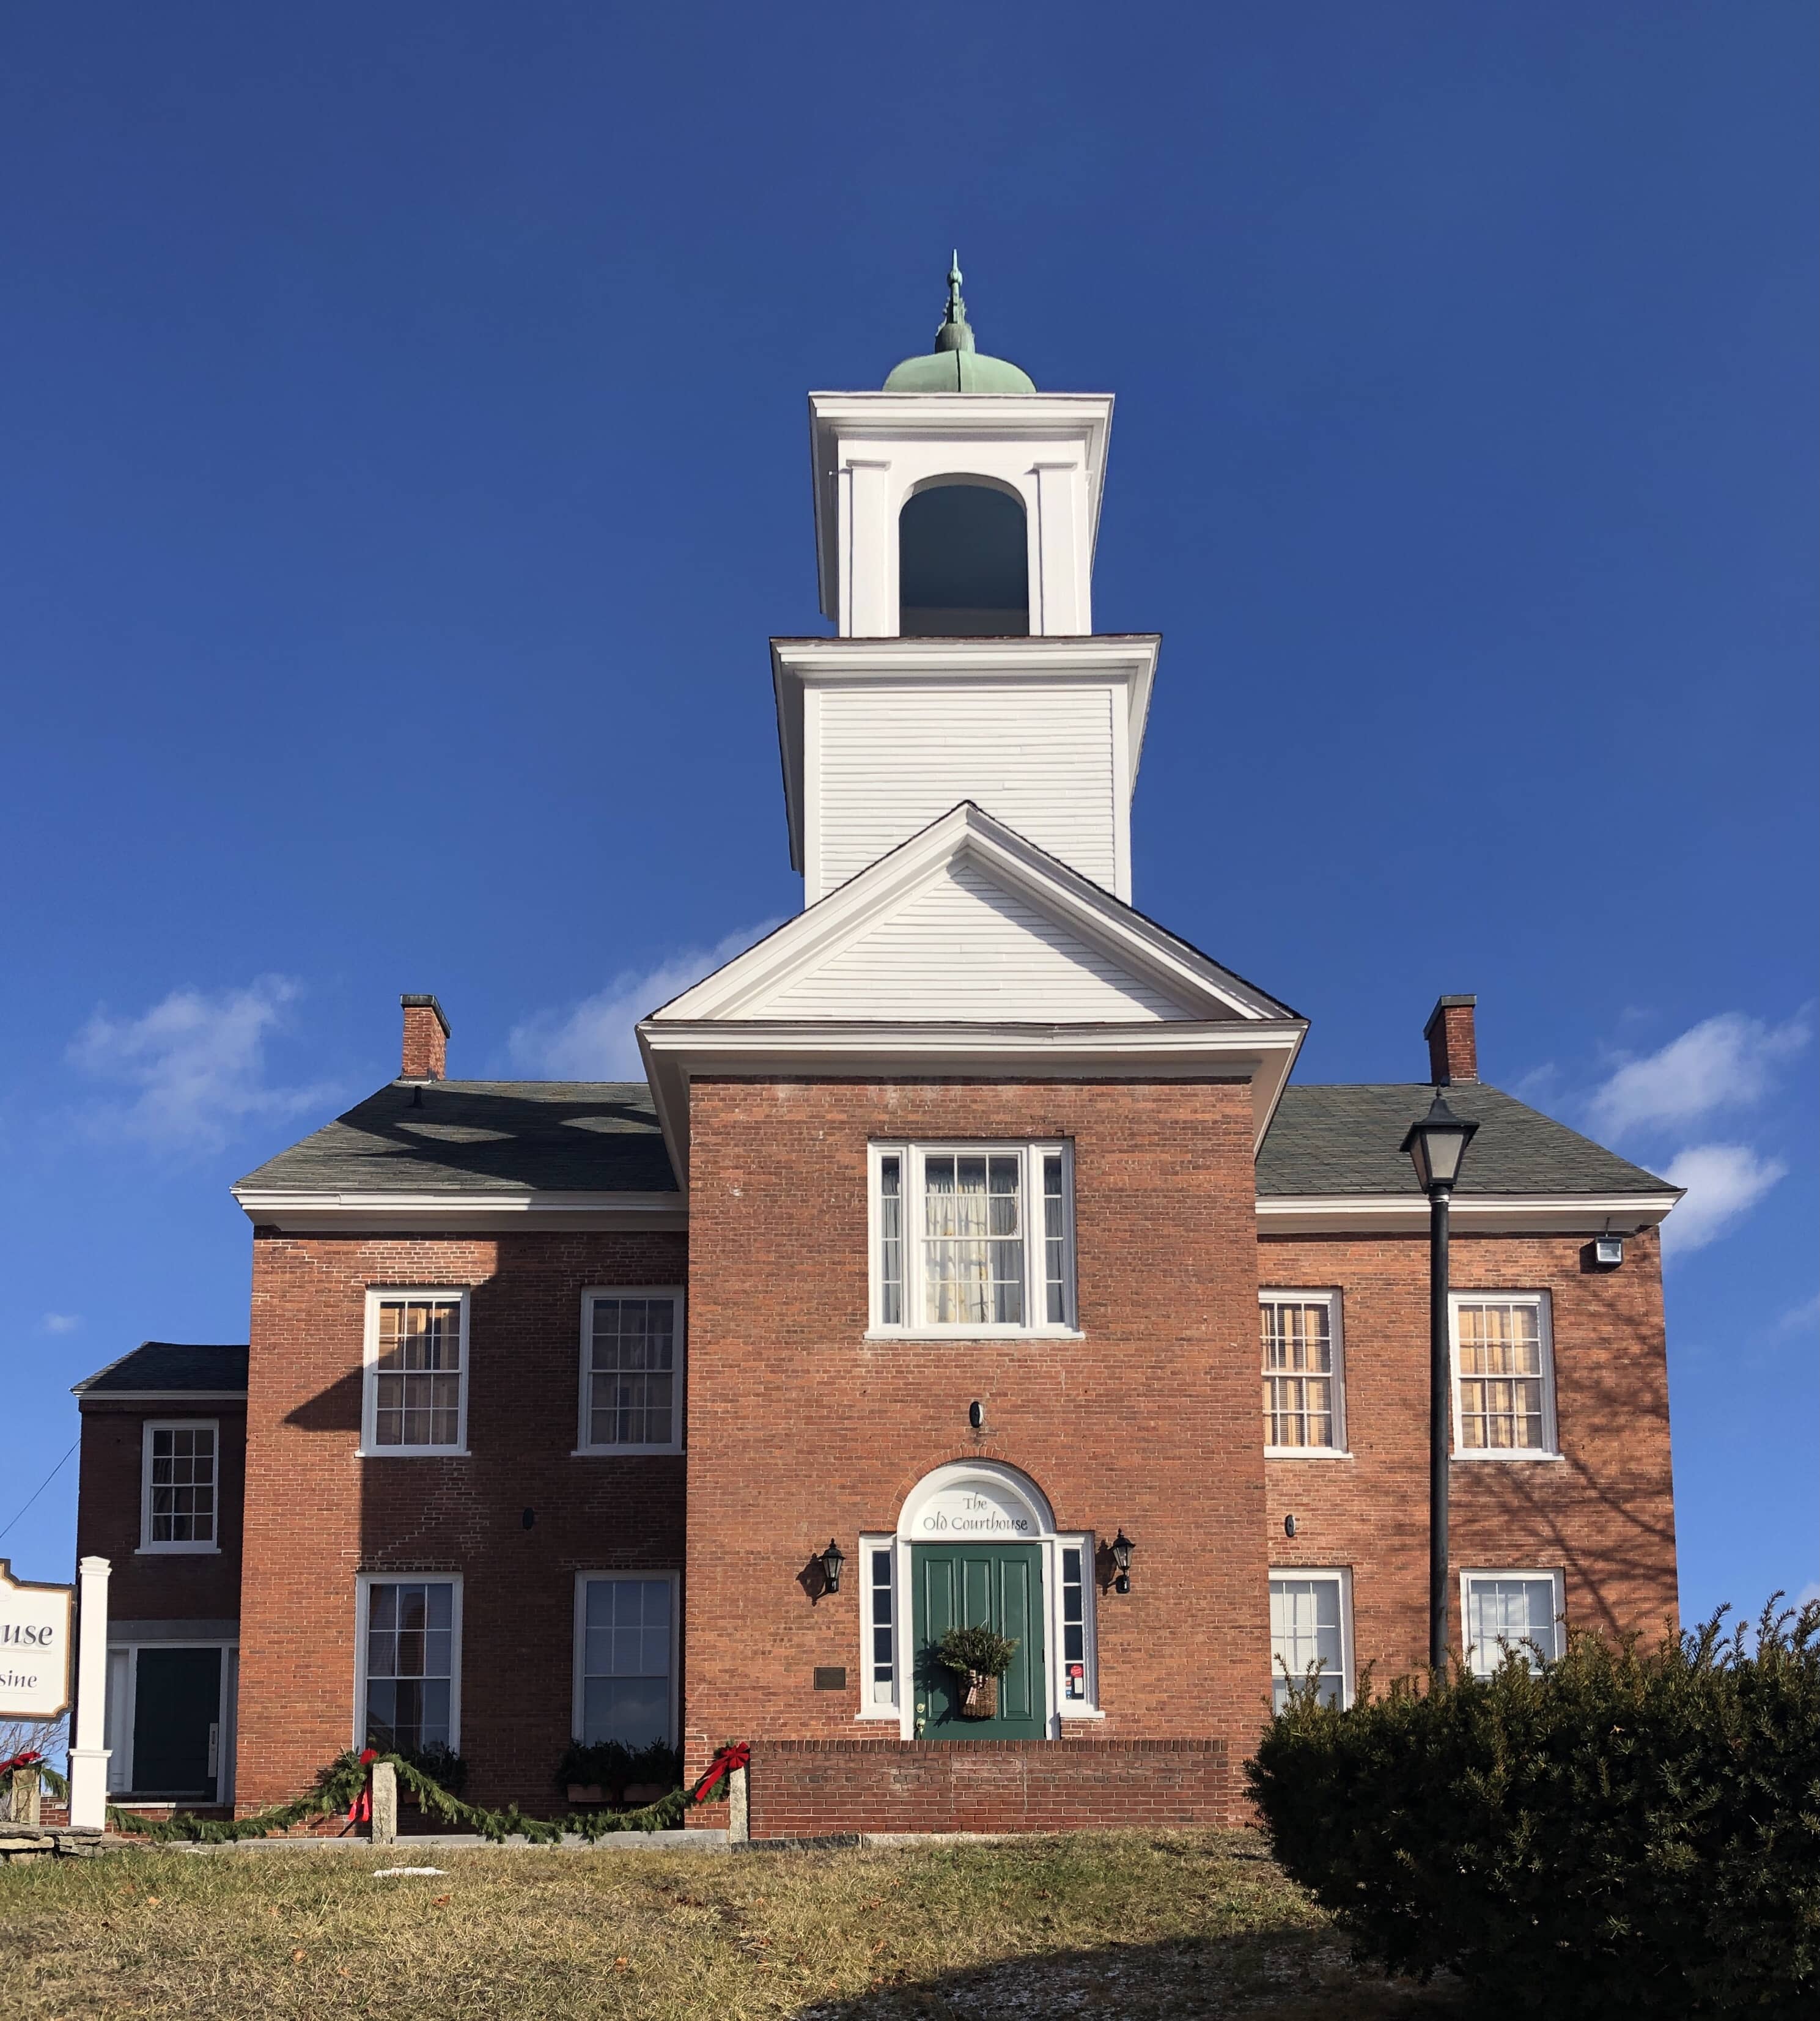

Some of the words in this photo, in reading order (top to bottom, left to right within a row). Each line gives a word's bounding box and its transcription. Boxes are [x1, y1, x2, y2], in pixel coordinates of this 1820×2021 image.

[962, 1492, 988, 1512] The
[923, 1511, 947, 1531] Old
[951, 1511, 1028, 1533] Courthouse
